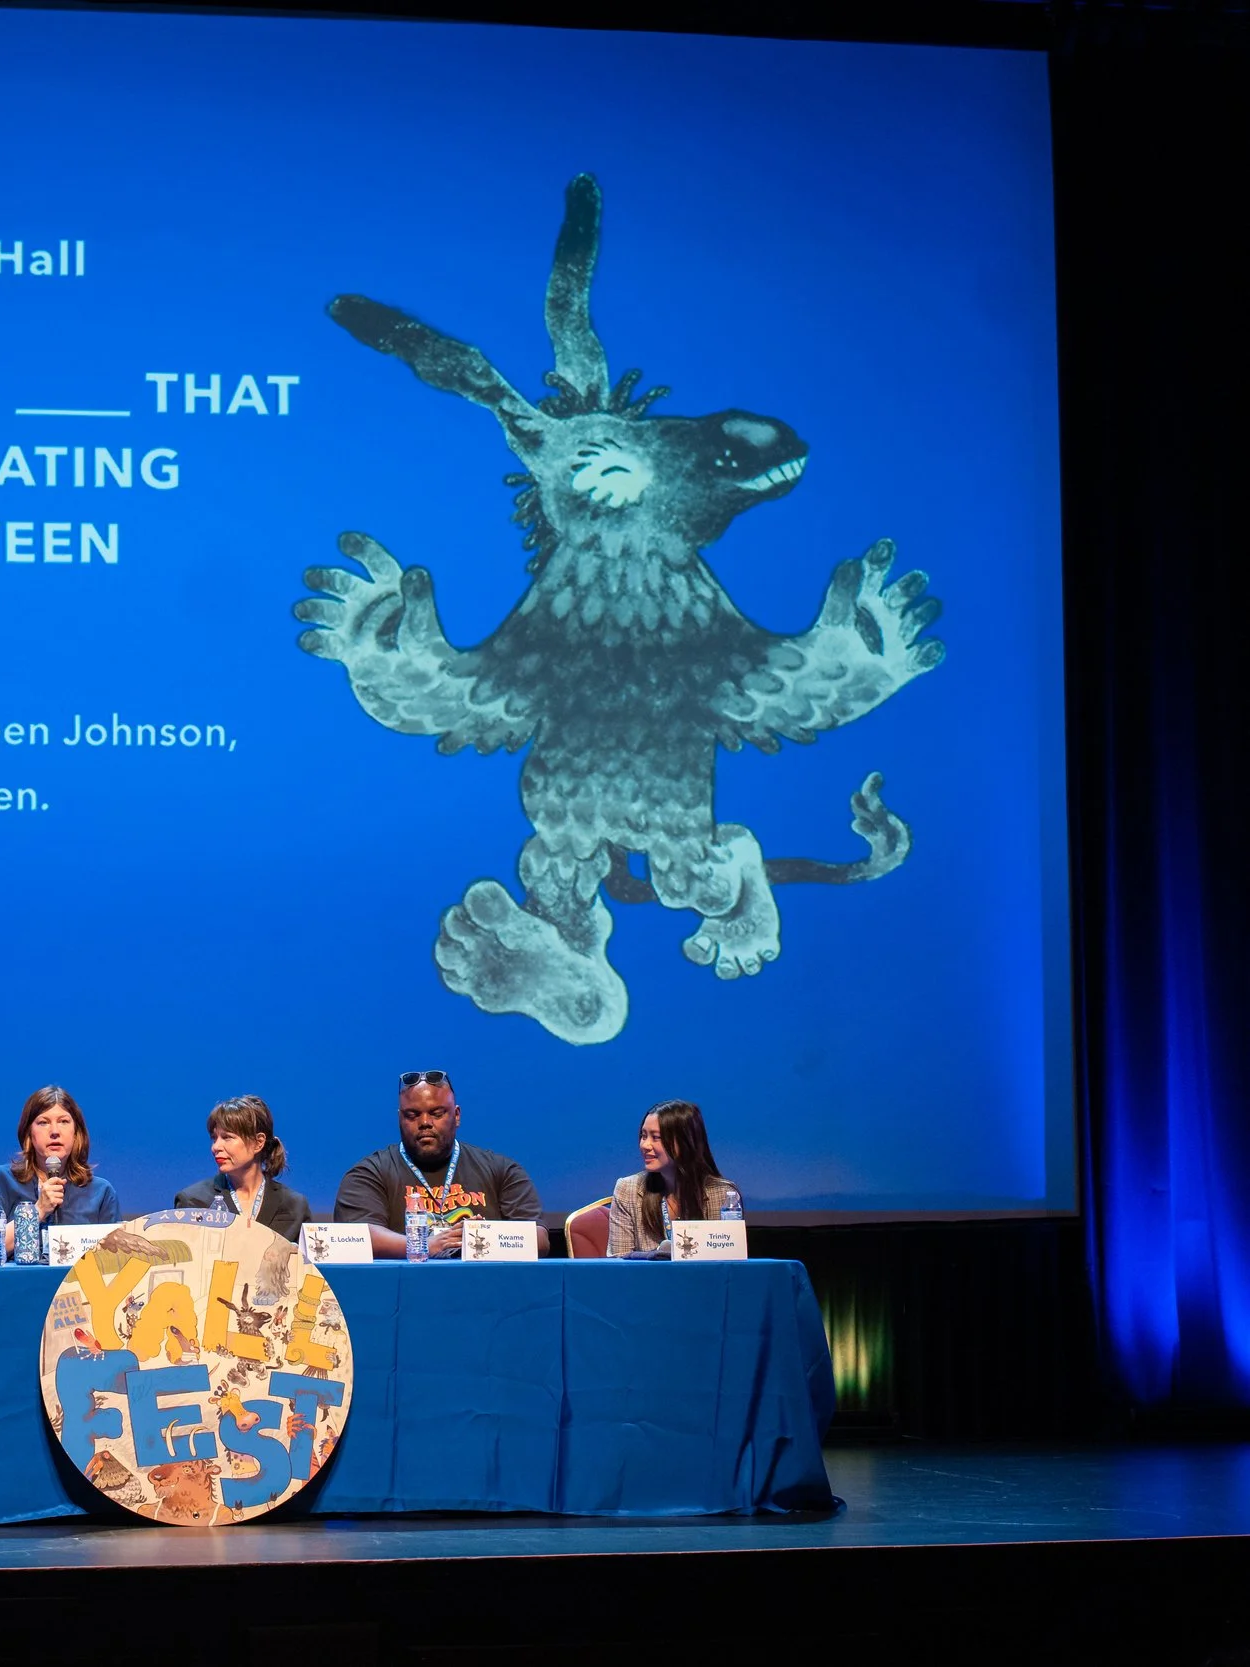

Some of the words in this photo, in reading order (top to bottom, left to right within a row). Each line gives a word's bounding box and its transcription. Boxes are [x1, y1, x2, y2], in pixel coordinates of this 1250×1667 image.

[146, 373, 300, 416] THAT
[63, 713, 237, 752] Johnson,
[706, 1241, 735, 1249] Nguyen
[708, 1233, 731, 1241] Trinity
[55, 1347, 346, 1507] FEST
